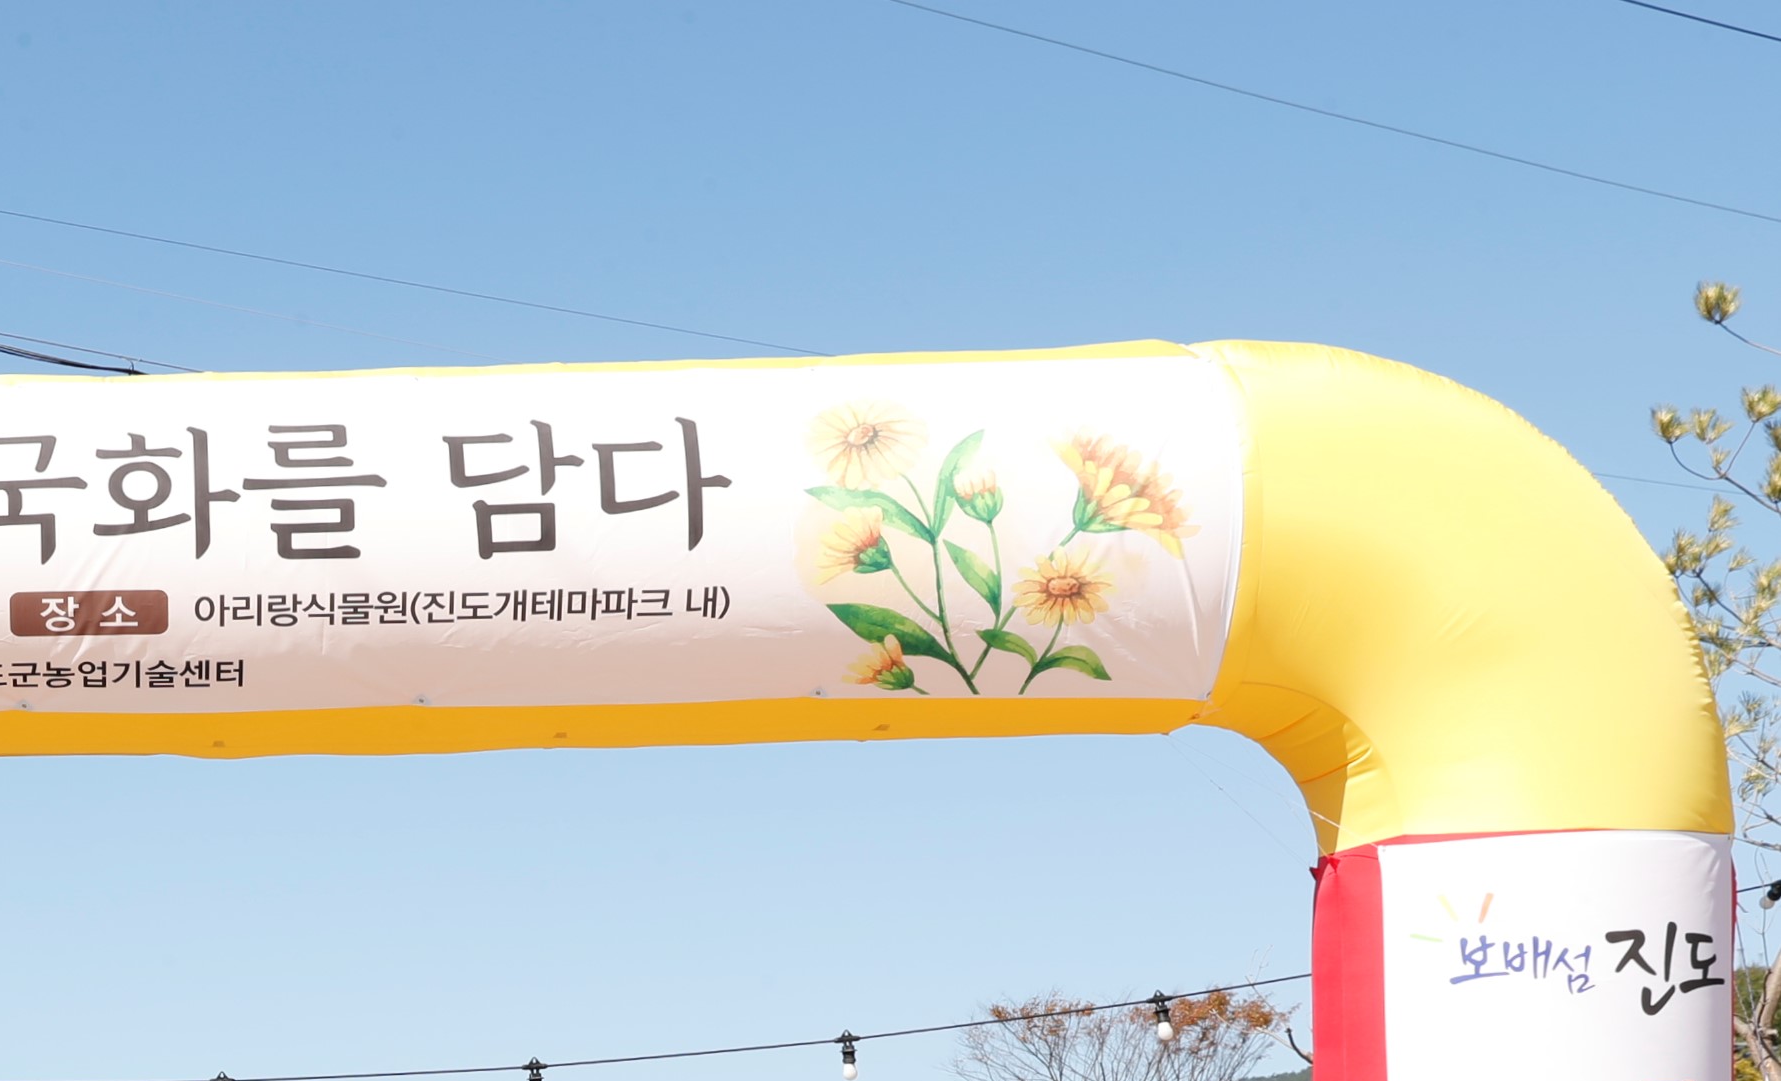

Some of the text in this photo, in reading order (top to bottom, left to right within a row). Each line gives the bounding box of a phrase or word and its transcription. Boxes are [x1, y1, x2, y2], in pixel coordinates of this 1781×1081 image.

[442, 417, 732, 560] 담다
[1449, 920, 1726, 1017] 보배섬 진도
